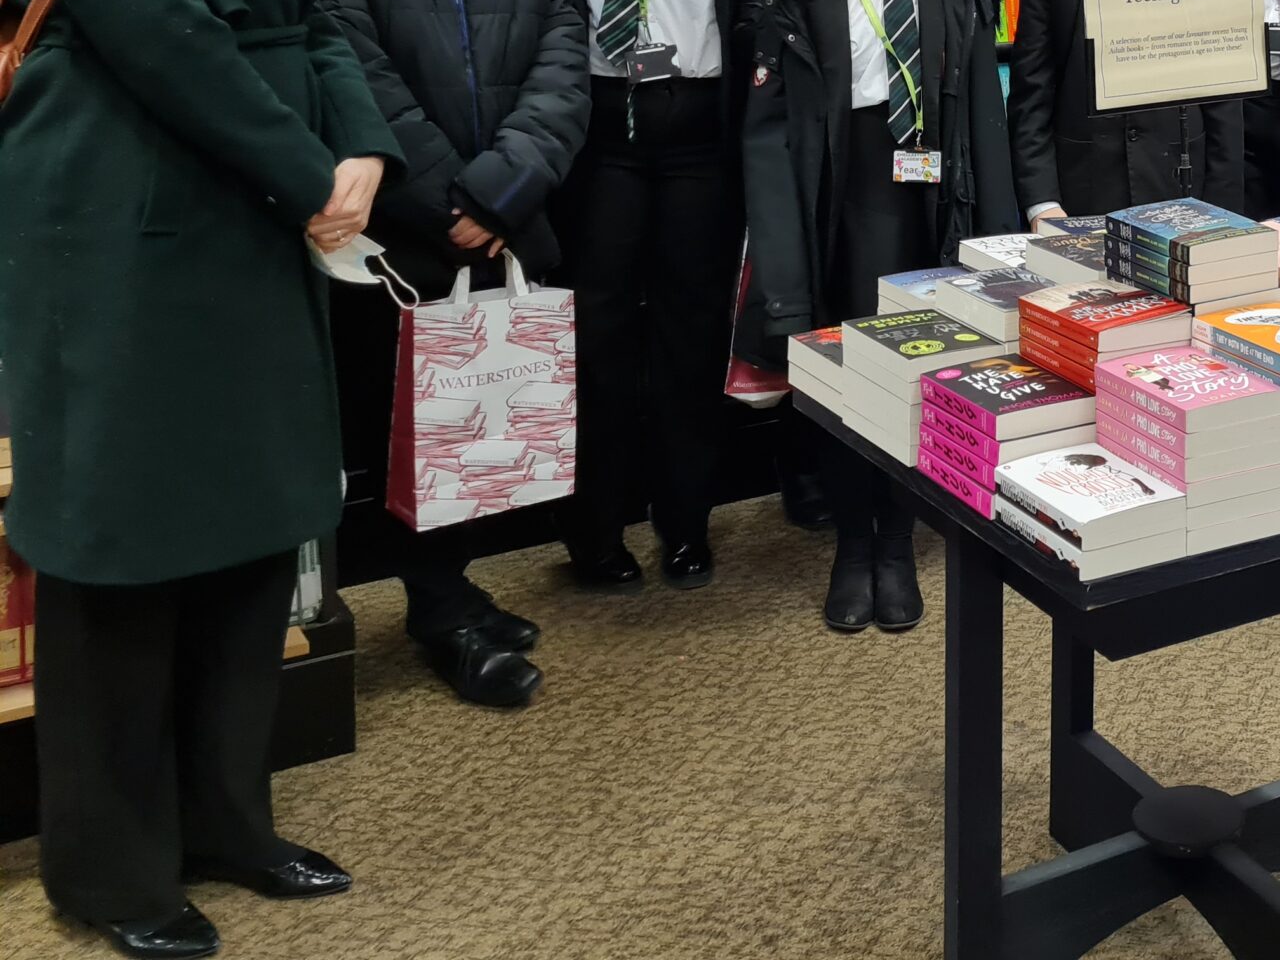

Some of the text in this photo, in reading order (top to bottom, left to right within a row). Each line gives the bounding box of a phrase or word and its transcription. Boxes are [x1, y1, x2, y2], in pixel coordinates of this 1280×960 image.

[1127, 44, 1143, 52] books
[1116, 54, 1130, 62] have
[1089, 298, 1166, 322] GAMES
[1216, 333, 1229, 346] THEY
[1229, 338, 1239, 352] BOTH
[1240, 344, 1249, 356] DIE
[1263, 352, 1274, 365] END
[1152, 353, 1174, 365] A
[1160, 360, 1192, 375] PHO
[438, 359, 552, 390] WATERSTONES
[958, 368, 999, 383] THE
[972, 371, 1024, 390] HATE
[1169, 366, 1216, 383] LOVE
[1000, 382, 1046, 401] GIVE
[1167, 373, 1249, 402] Story
[933, 387, 976, 420] THUG
[1148, 397, 1160, 414] LOVE
[934, 411, 979, 448] THUG
[1148, 420, 1160, 438] LOVE
[933, 438, 978, 473] THUG
[930, 462, 972, 498] THUG
